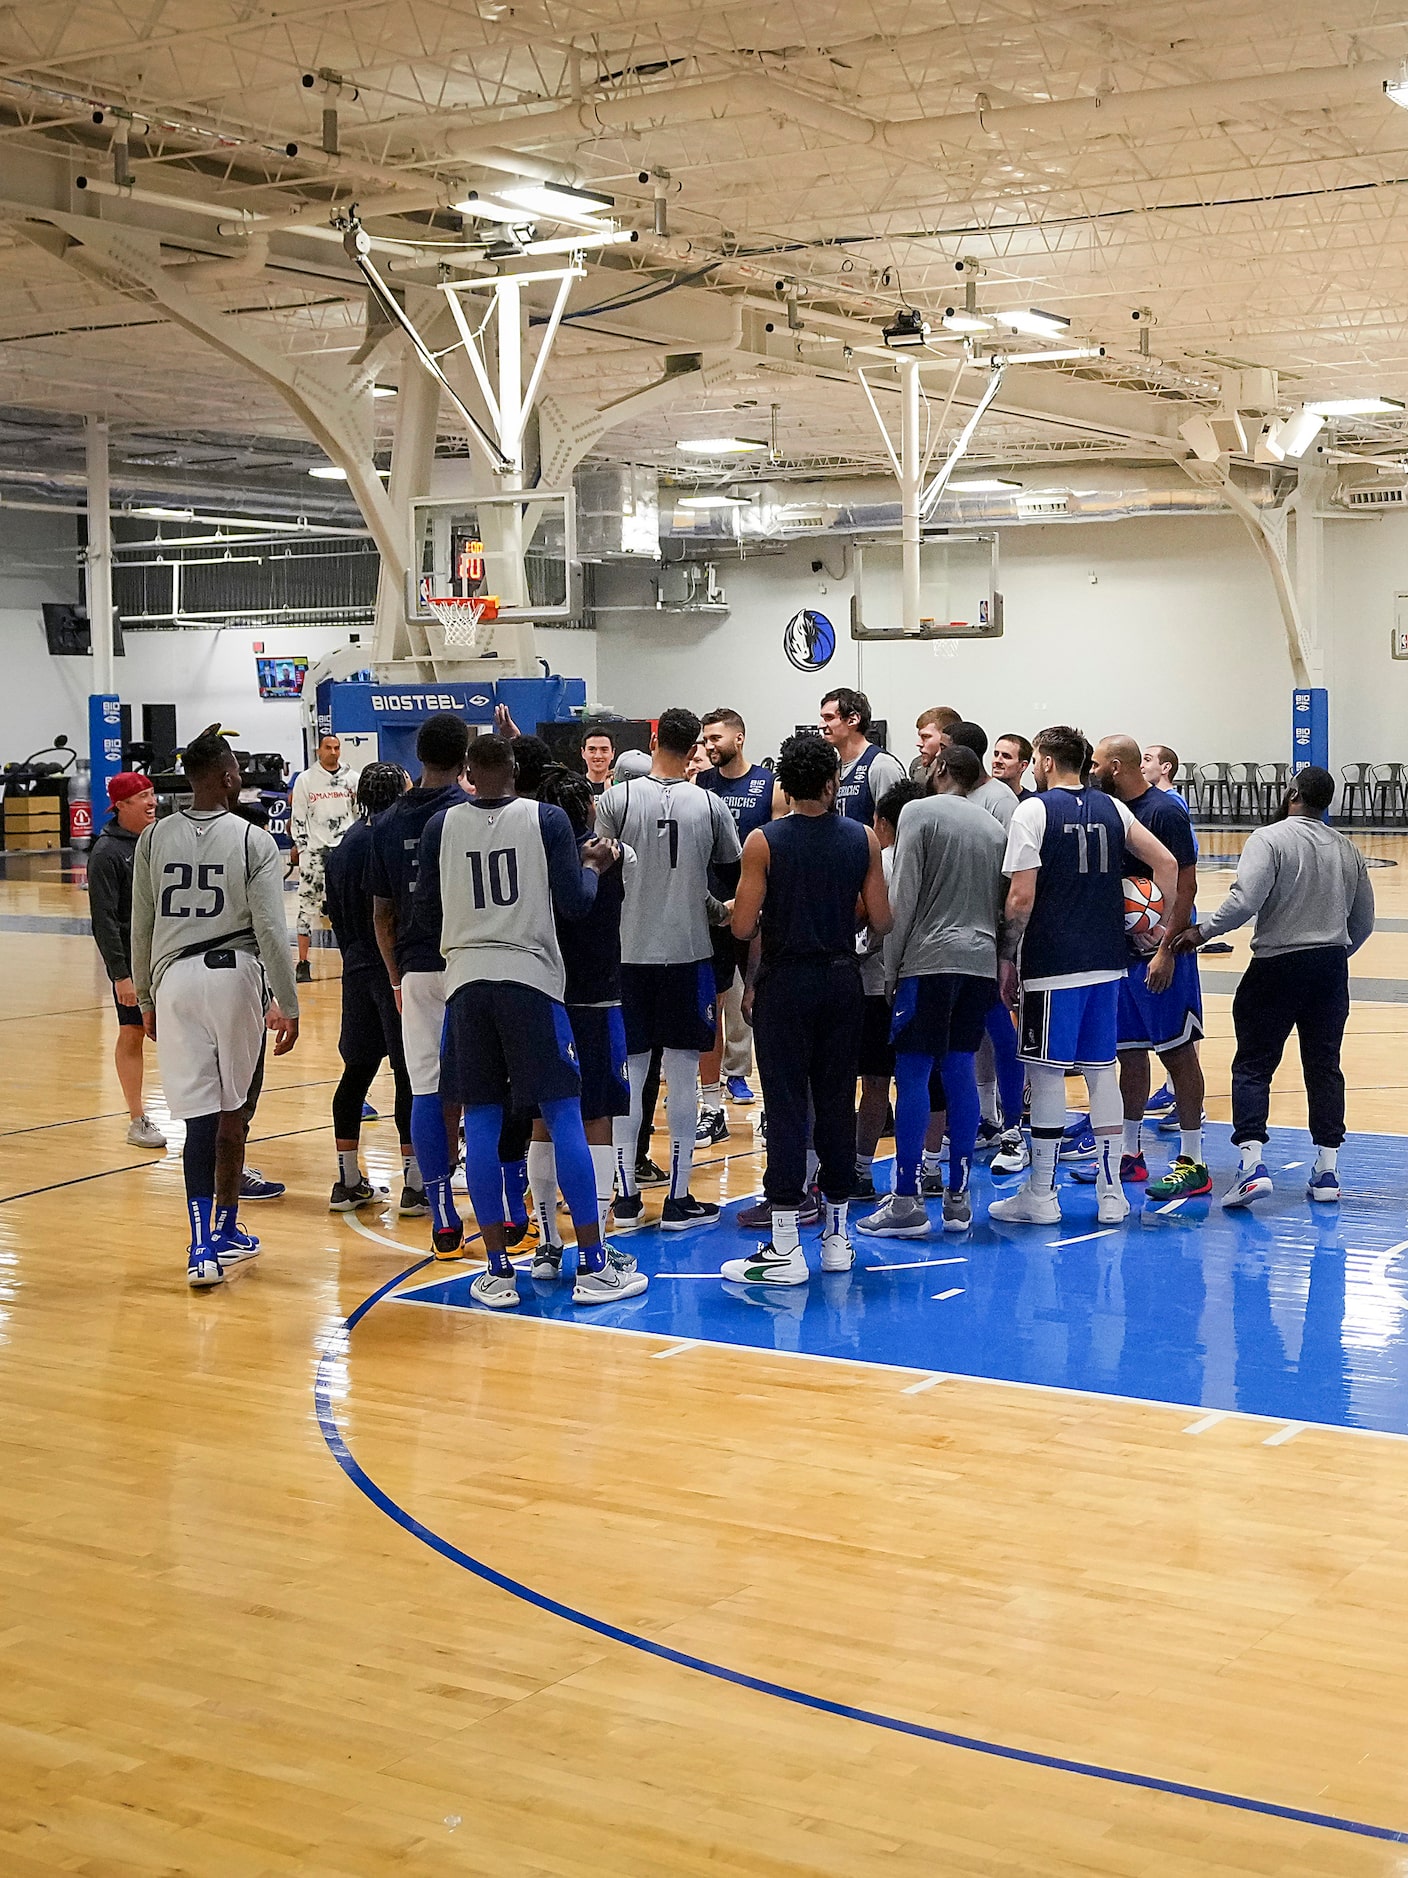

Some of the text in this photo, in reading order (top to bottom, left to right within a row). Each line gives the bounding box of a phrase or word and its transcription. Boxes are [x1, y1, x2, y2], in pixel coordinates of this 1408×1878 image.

[371, 694, 466, 711] BIOSTEEL
[656, 819, 680, 869] 7
[1063, 823, 1109, 874] 77
[161, 862, 225, 918] 25
[465, 847, 520, 910] 10
